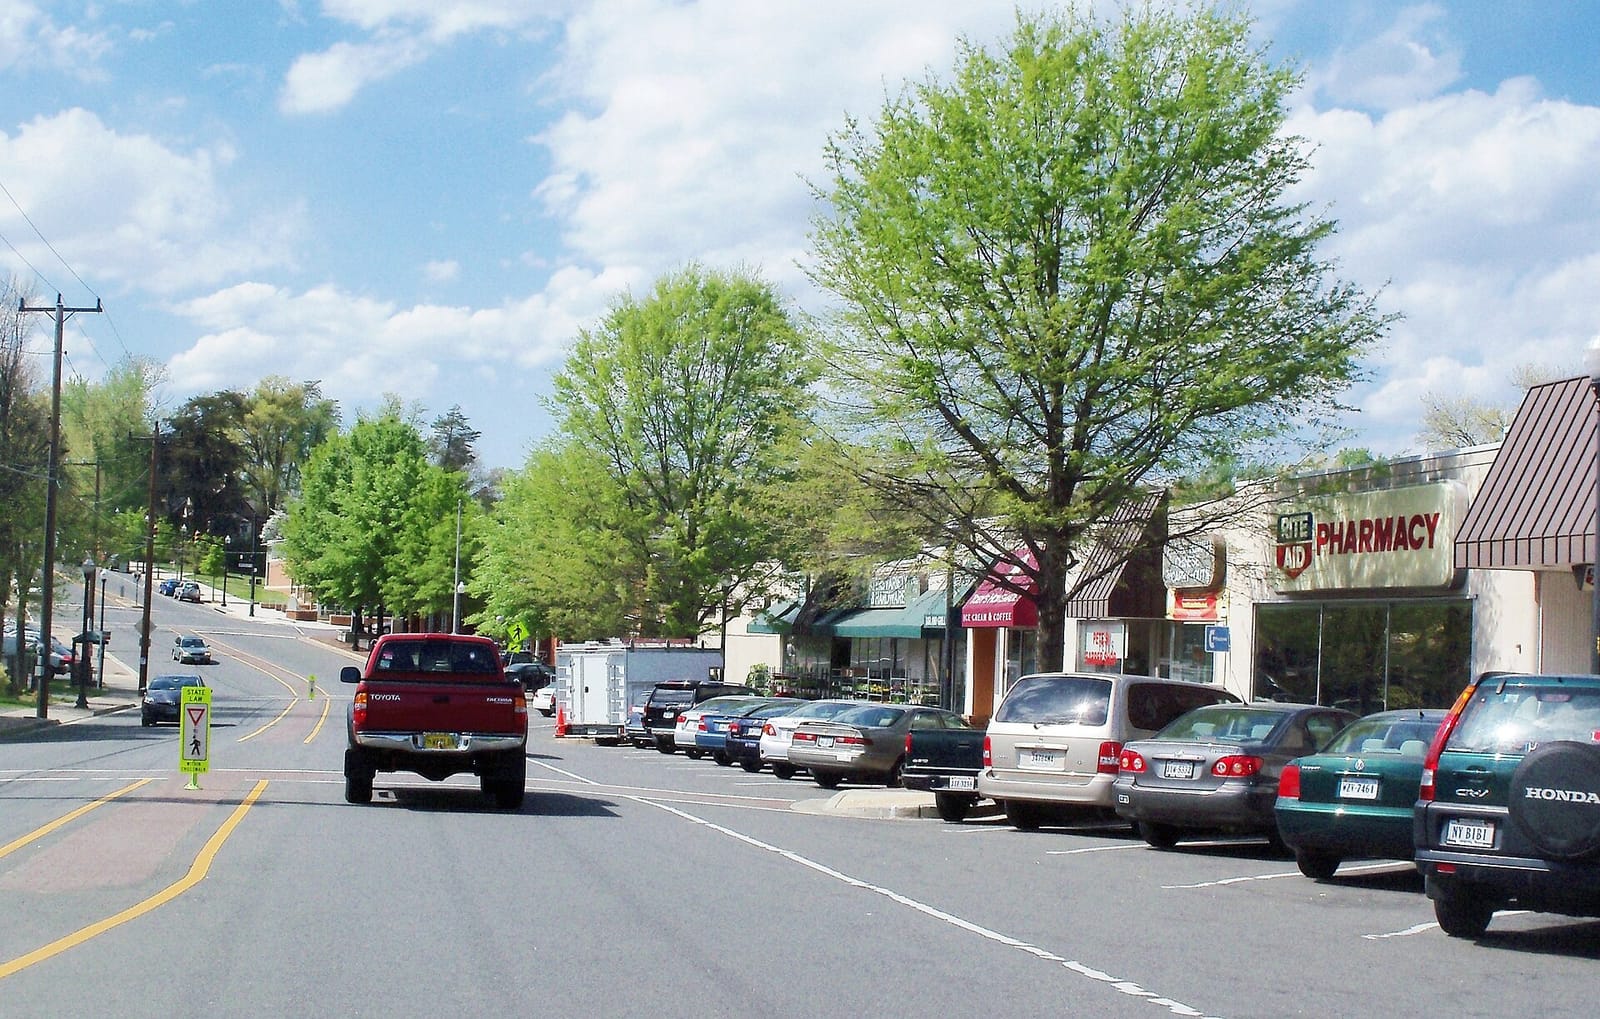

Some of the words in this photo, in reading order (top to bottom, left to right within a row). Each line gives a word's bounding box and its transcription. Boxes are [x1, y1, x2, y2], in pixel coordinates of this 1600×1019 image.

[1280, 514, 1309, 539] RITE
[1316, 512, 1440, 556] PHARMACY
[1283, 545, 1306, 569] AID
[971, 613, 987, 622] CREAM
[993, 612, 1012, 622] COFFEE
[369, 693, 401, 701] TOYOTA
[1525, 787, 1600, 804] HONDA
[1451, 825, 1464, 839] NY
